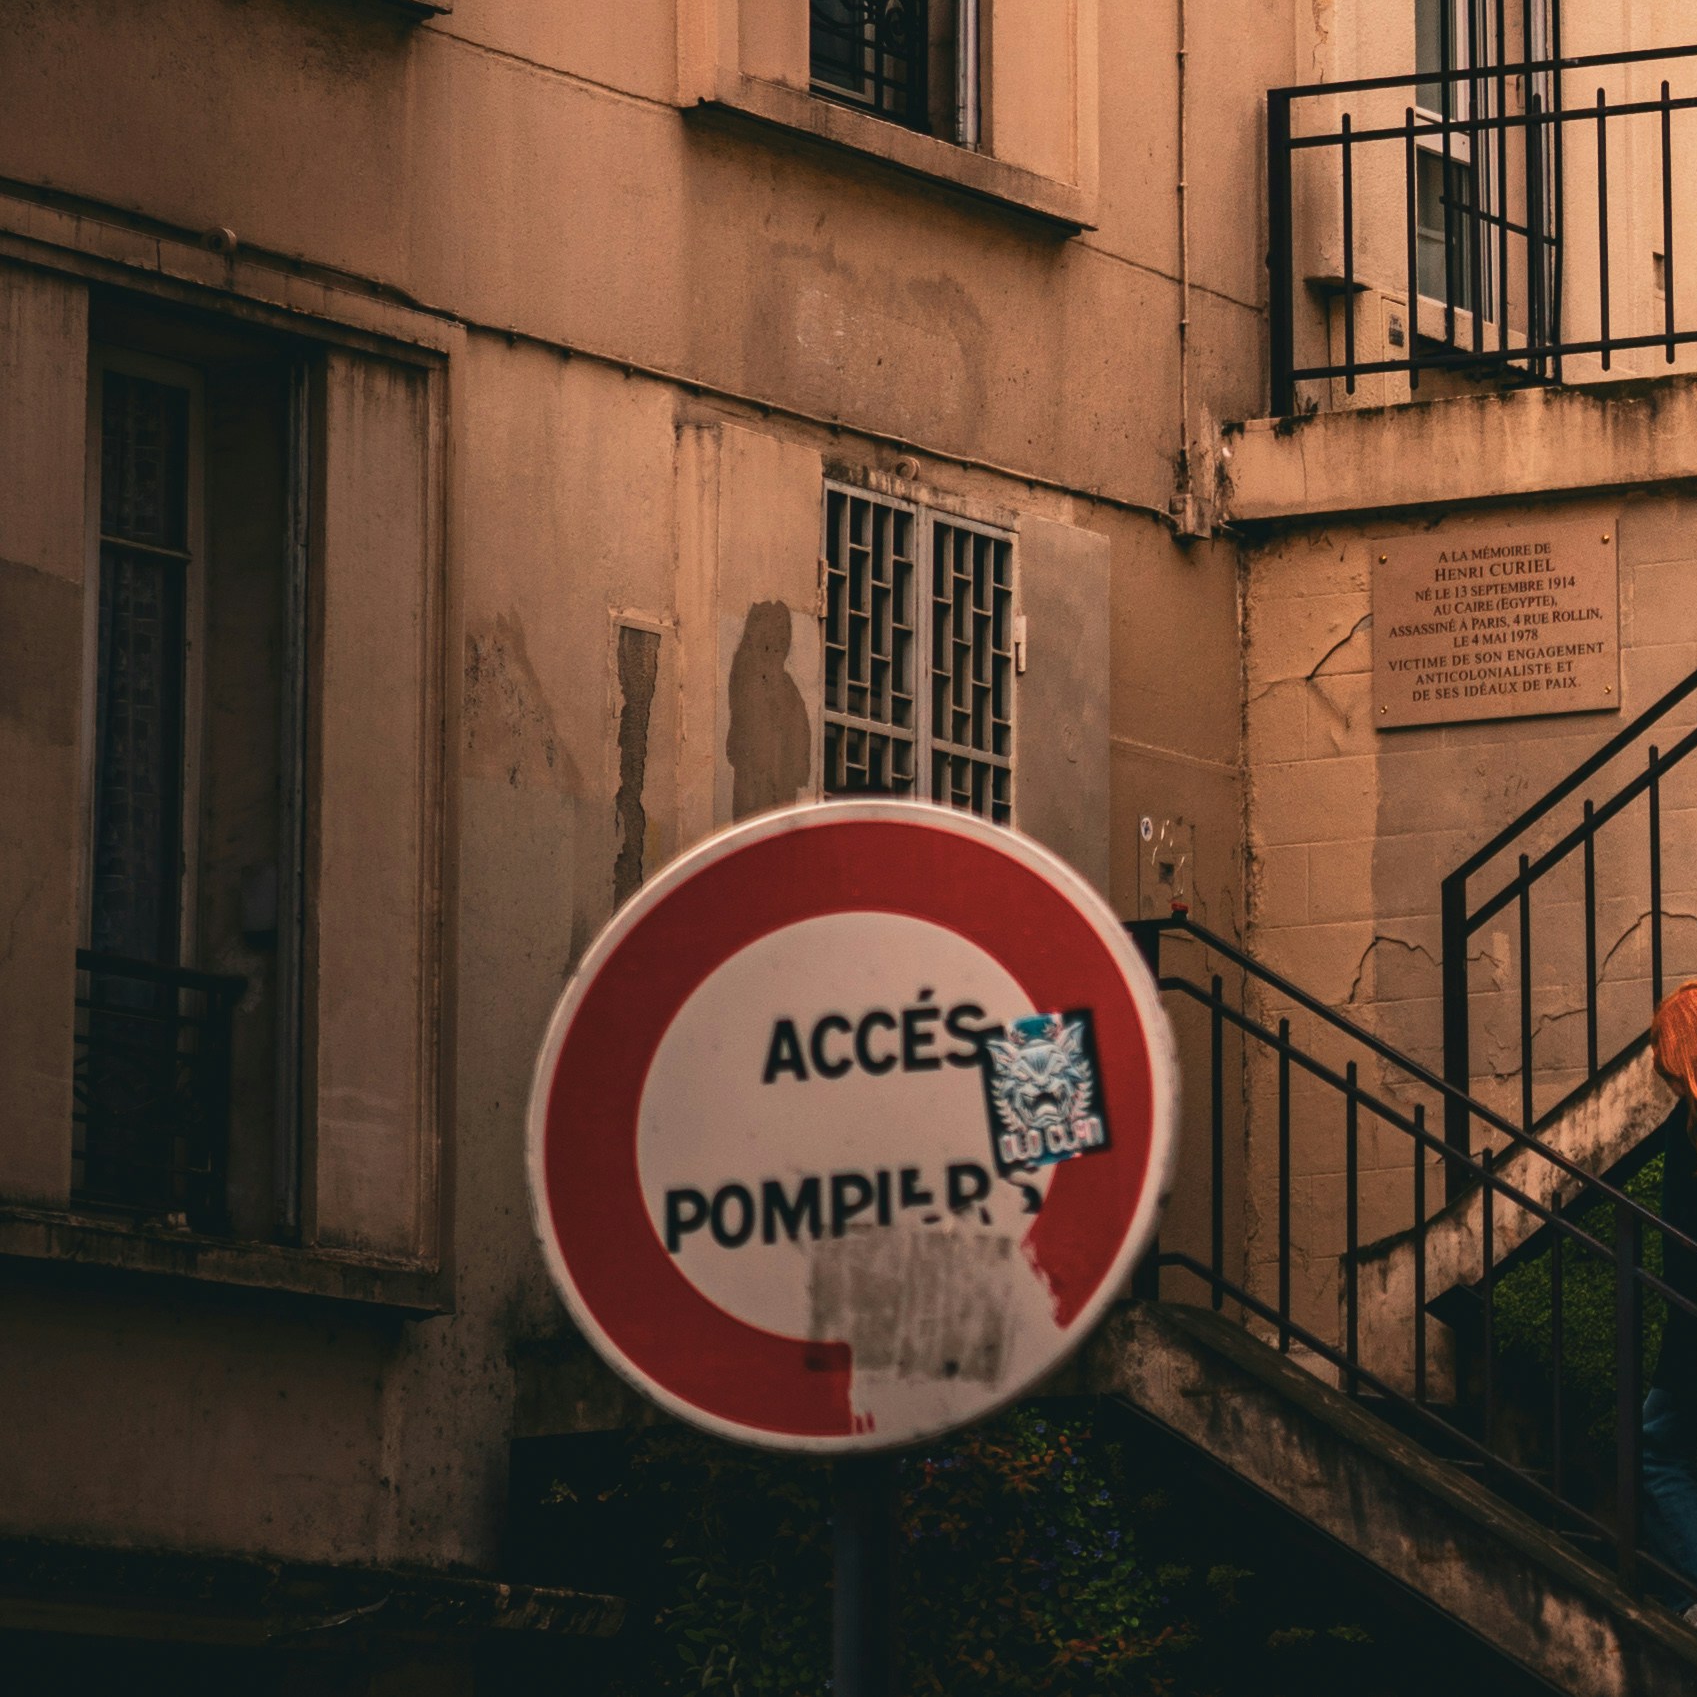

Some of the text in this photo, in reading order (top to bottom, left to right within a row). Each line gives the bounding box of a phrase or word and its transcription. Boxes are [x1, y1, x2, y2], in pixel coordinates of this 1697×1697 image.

[1438, 543, 1552, 563] A LA MÉMOIRE DE
[1434, 558, 1556, 582] HENRI CURIEL
[1415, 575, 1576, 603] NÉ LE 13 SEPTEMBRE 1914
[1433, 603, 1452, 617] AU
[1454, 600, 1494, 615] CAIRE
[1389, 619, 1456, 638] ASSASSINÉ
[1471, 616, 1510, 631] PARIS,
[1513, 614, 1520, 627] 4
[1524, 613, 1549, 626] RUE
[1552, 608, 1603, 623] ROLLIN,
[1454, 629, 1538, 647] LE 4 MAI 1978
[1388, 642, 1604, 671] VICTIME DE SON ENGAGEMENT
[1416, 661, 1574, 685] ANTICOLONIALISTE ET
[1412, 689, 1431, 702] DE
[1435, 687, 1460, 699] SES
[1464, 681, 1518, 697] IDÉAUX
[1523, 679, 1542, 692] DE
